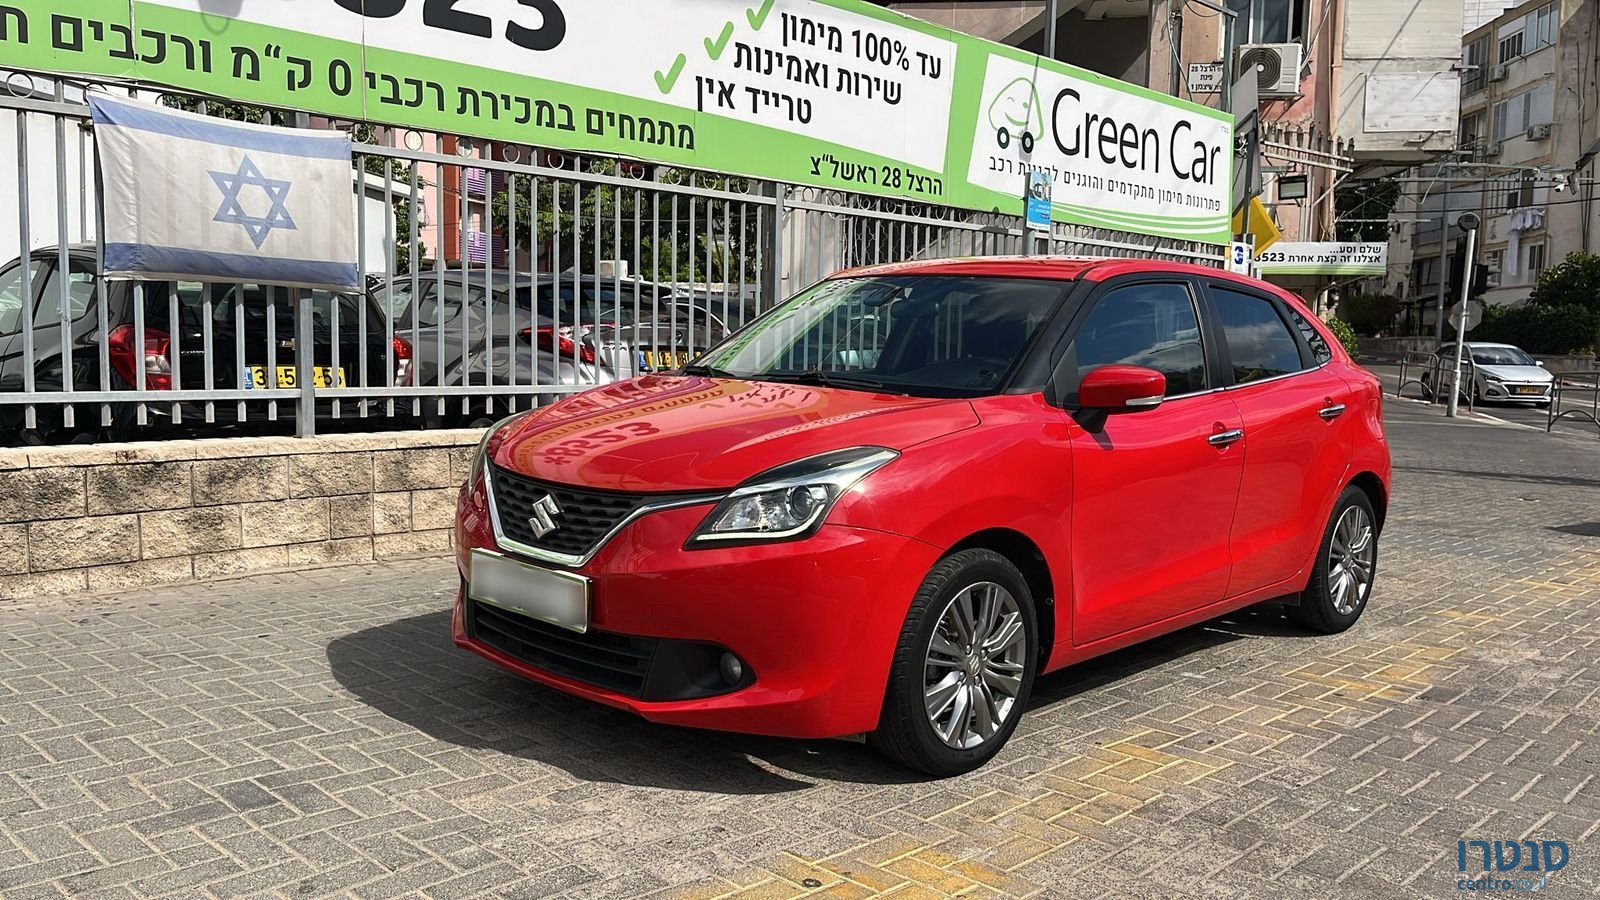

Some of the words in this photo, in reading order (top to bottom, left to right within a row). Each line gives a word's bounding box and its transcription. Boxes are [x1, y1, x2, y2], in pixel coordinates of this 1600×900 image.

[51, 13, 212, 73] ורכבים
[781, 12, 842, 53] מימון
[852, 30, 909, 71] 100%
[329, 59, 351, 96] 0
[734, 42, 828, 88] ואמינות
[916, 51, 941, 79] עד
[365, 71, 445, 111] רכבי
[695, 75, 735, 112] אין
[836, 67, 901, 105] שירות
[456, 86, 576, 131] במכירת
[745, 86, 811, 124] טרייד
[586, 108, 694, 150] מתמחים
[1052, 88, 1159, 173] Green
[1170, 120, 1220, 185] Car
[882, 166, 901, 189] 28
[989, 156, 1012, 173] רכב
[906, 169, 942, 195] הרצל
[1064, 170, 1103, 190] והוגנים
[1108, 179, 1154, 200] מתקדמים
[1158, 188, 1182, 205] מימון
[1185, 194, 1220, 211] פתרונות
[1288, 255, 1314, 263] אחרת
[1317, 255, 1337, 264] קצת
[1340, 255, 1351, 263] זה
[1353, 254, 1381, 263] אצלנו
[1360, 245, 1381, 254] שלם
